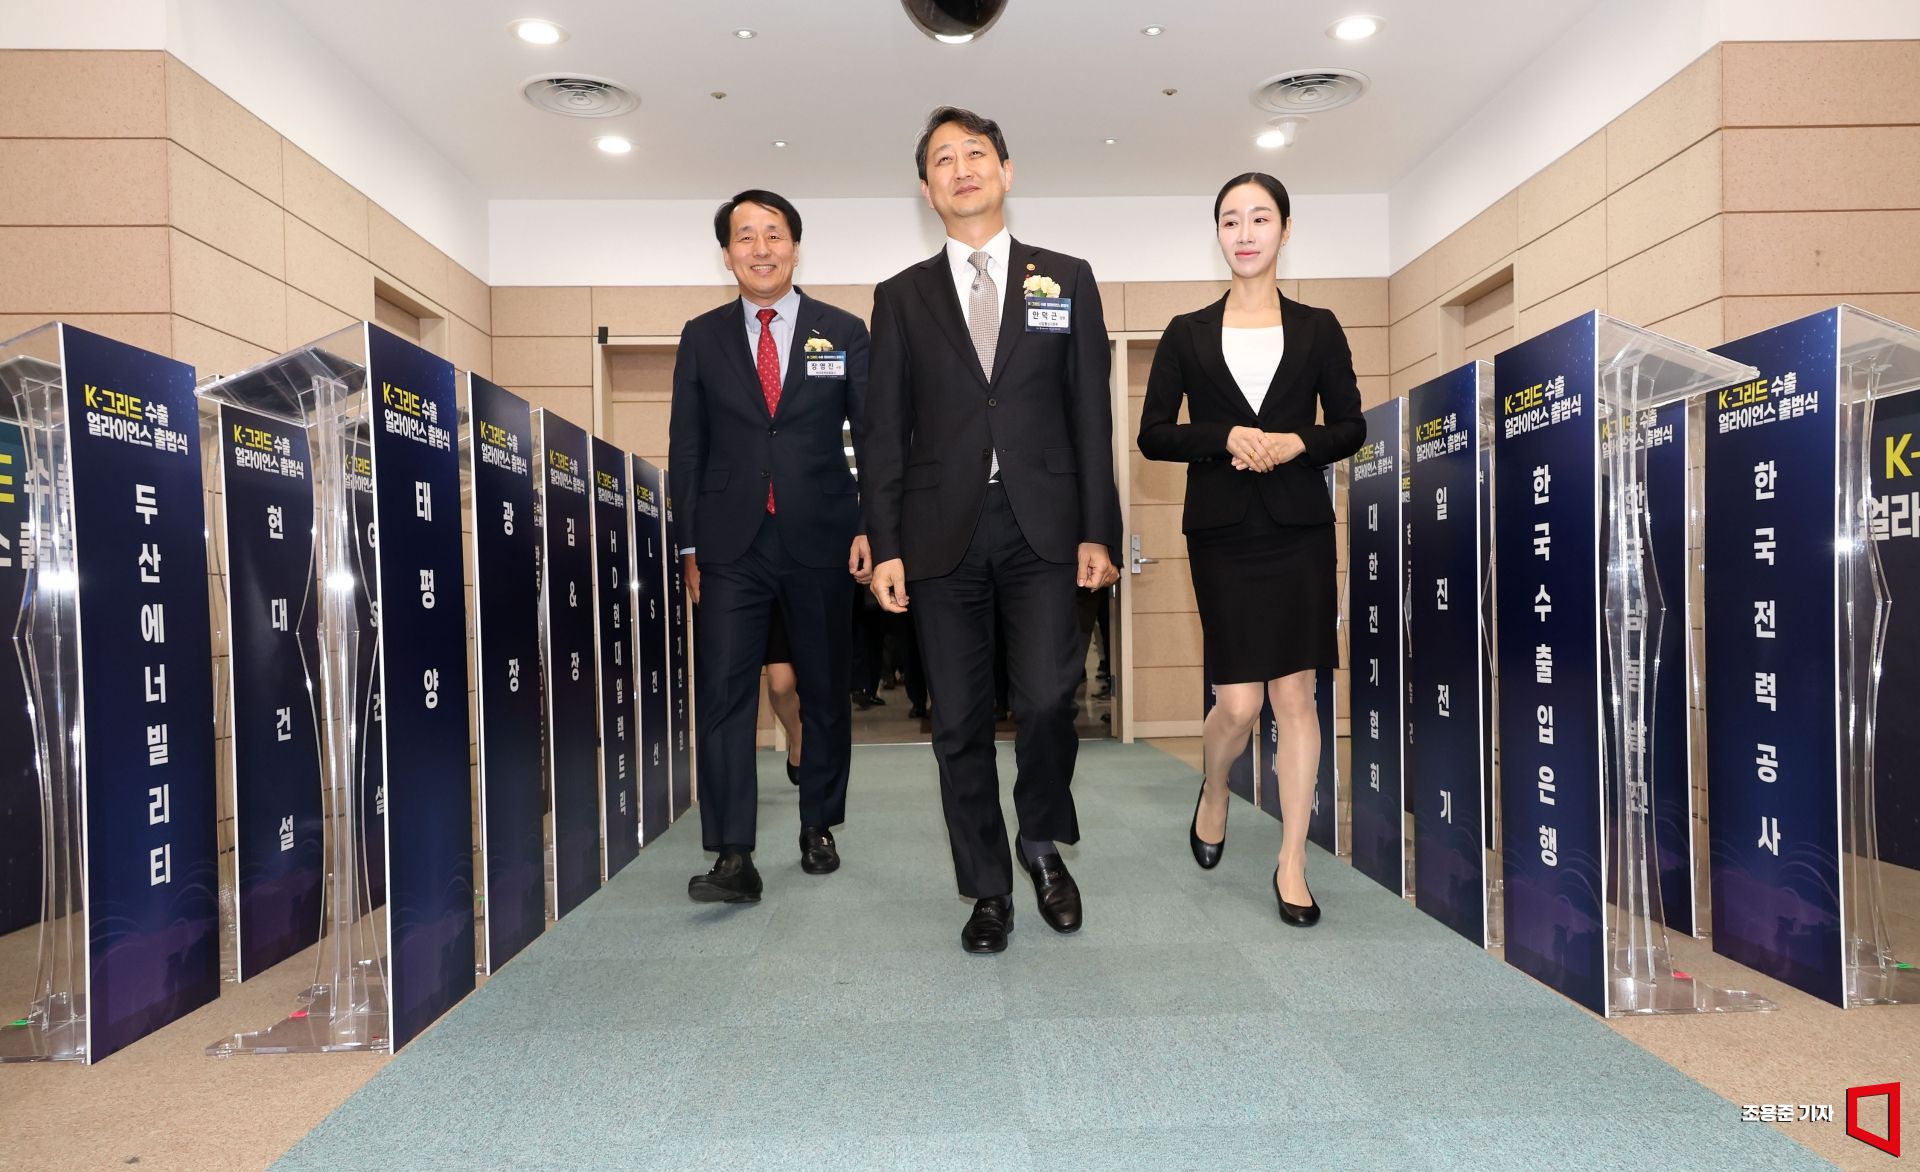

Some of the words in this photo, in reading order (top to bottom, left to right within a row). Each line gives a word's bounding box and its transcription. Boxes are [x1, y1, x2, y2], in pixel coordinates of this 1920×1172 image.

[84, 384, 143, 420] K-그리드
[145, 401, 169, 428] 수출
[382, 382, 421, 417] K-그리드
[421, 398, 438, 424] 수출
[1504, 383, 1543, 415] K-그리드
[1544, 375, 1565, 401] 수출
[1718, 379, 1768, 410] K-그리드
[1770, 371, 1797, 397] 수출
[384, 408, 428, 444] 얼라이언스
[428, 424, 451, 452] 출범식
[1415, 418, 1443, 442] K-그리드
[1443, 412, 1457, 433] 수출
[1504, 406, 1550, 439] 얼라이언스
[1551, 393, 1582, 425] 출범식
[1718, 402, 1776, 434] 얼라이언스
[1779, 390, 1818, 421] 출범식
[86, 411, 153, 447] 얼라이언스
[154, 427, 188, 455] 출범식
[233, 424, 273, 452] K-그리드
[273, 435, 291, 457] 수출
[480, 420, 507, 448] K-그리드
[506, 432, 519, 453] 수출
[1374, 440, 1385, 458] 수출
[1416, 438, 1447, 463] 얼라이언스
[1447, 429, 1468, 453] 출범식
[1646, 424, 1673, 449] 출범식
[235, 446, 280, 474] 얼라이언스
[280, 456, 305, 480] 출범식
[481, 442, 511, 470] 얼라이언스
[511, 454, 528, 477] 출범식
[549, 448, 570, 472] K-그리드
[569, 458, 579, 476] 수출
[1354, 460, 1377, 482] 얼라이언스
[1377, 455, 1393, 476] 출범식
[550, 467, 573, 491] 얼라이언스
[572, 475, 585, 496] 출범식
[1436, 487, 1452, 824] 일진전기
[1532, 464, 1558, 867] 한국수출입은행
[1753, 460, 1782, 856] 한국전력공사
[135, 484, 171, 886] 두산에너빌리티
[267, 505, 295, 852] 현대건설
